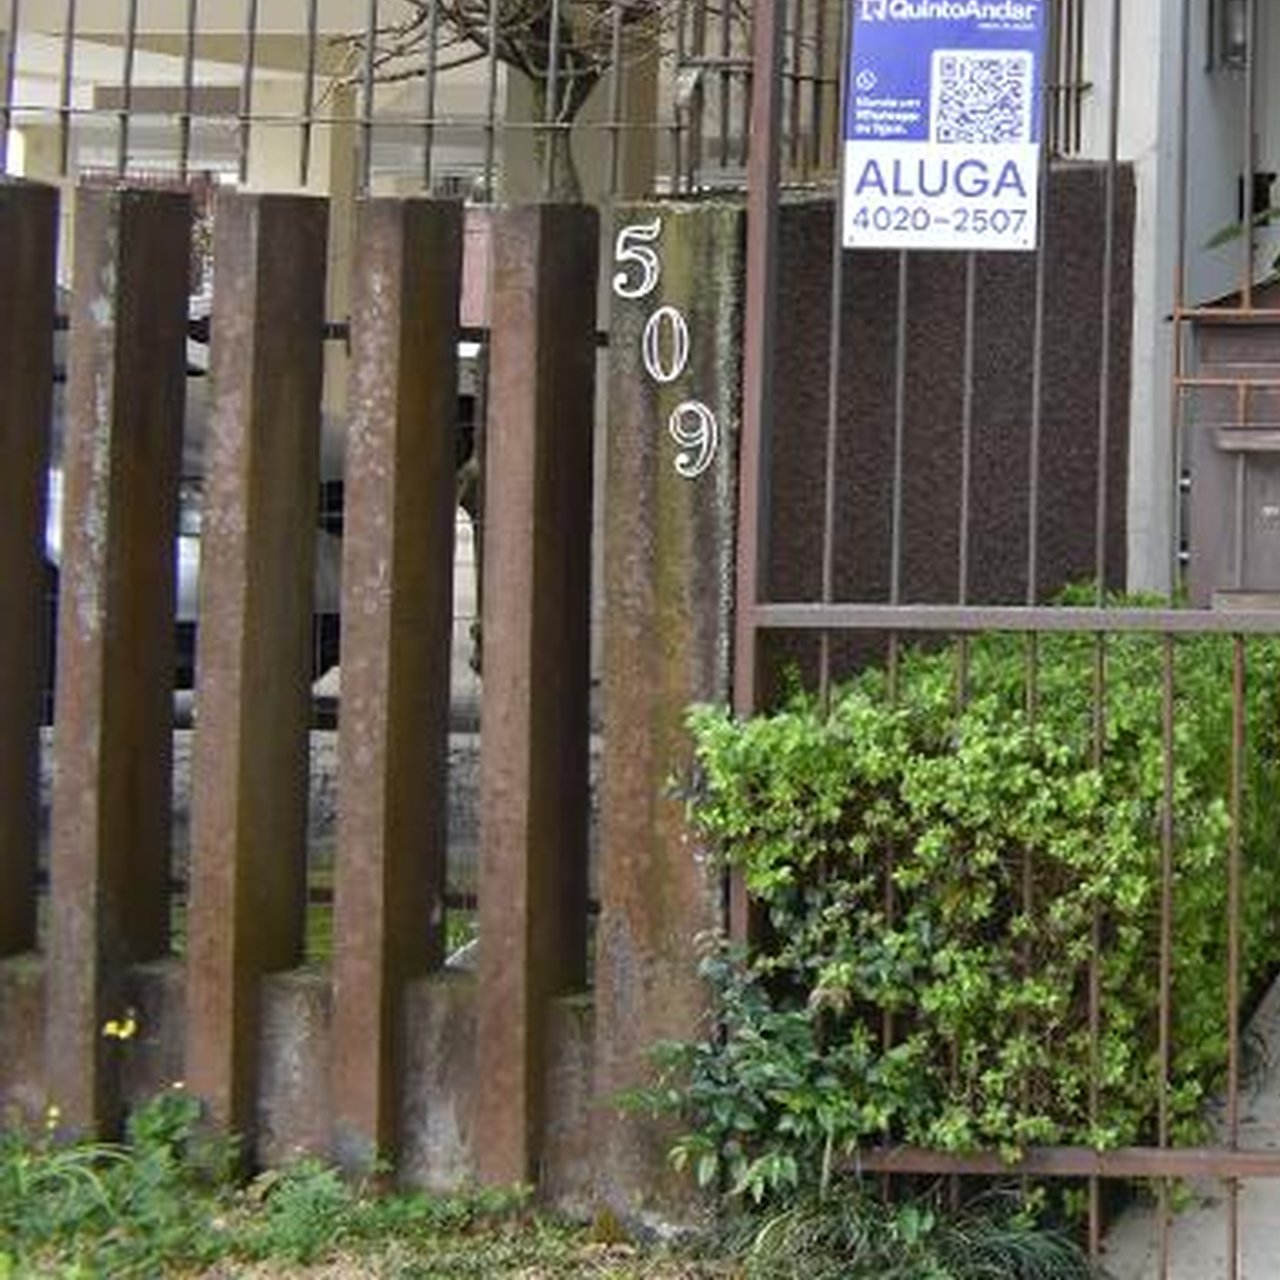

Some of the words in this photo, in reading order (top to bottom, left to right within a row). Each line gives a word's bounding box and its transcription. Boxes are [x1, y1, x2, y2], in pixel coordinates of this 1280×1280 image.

[855, 159, 1028, 198] ALUGA
[852, 206, 1028, 234] 4020-2507
[613, 216, 719, 478] 509
